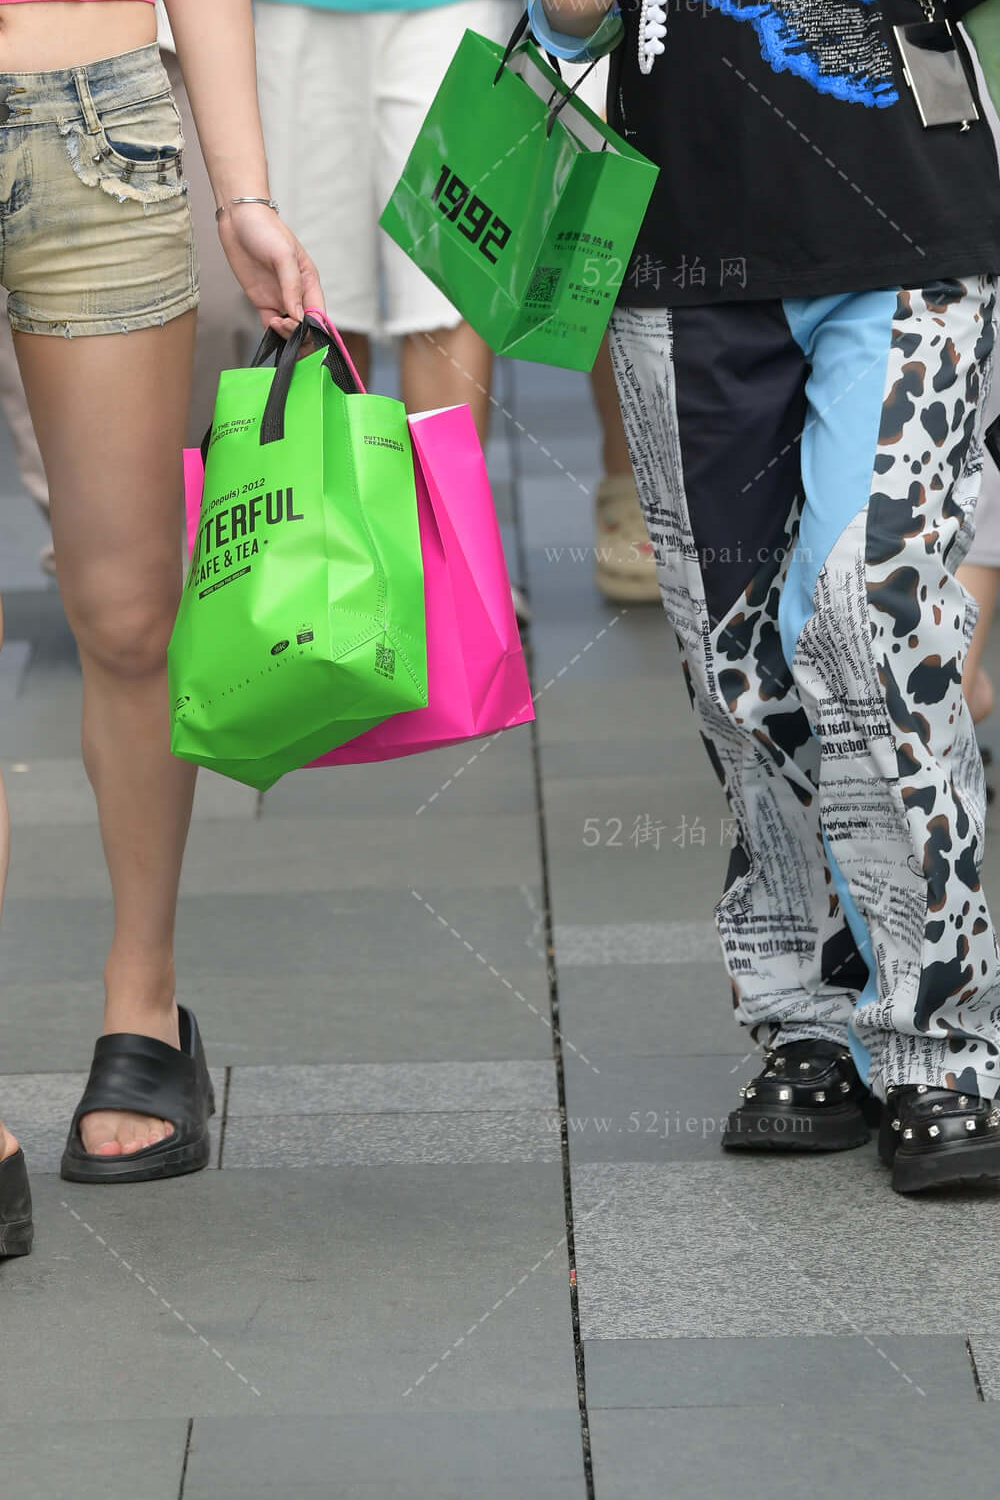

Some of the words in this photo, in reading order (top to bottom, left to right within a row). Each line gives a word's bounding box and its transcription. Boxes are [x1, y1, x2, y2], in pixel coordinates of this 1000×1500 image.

[431, 164, 512, 265] 1992
[217, 422, 231, 431] THE
[231, 417, 257, 426] GREAT
[241, 477, 266, 494] 2012
[224, 550, 233, 568] &
[236, 538, 259, 563] TEA
[702, 620, 714, 661] grayness
[842, 642, 862, 681] grayness
